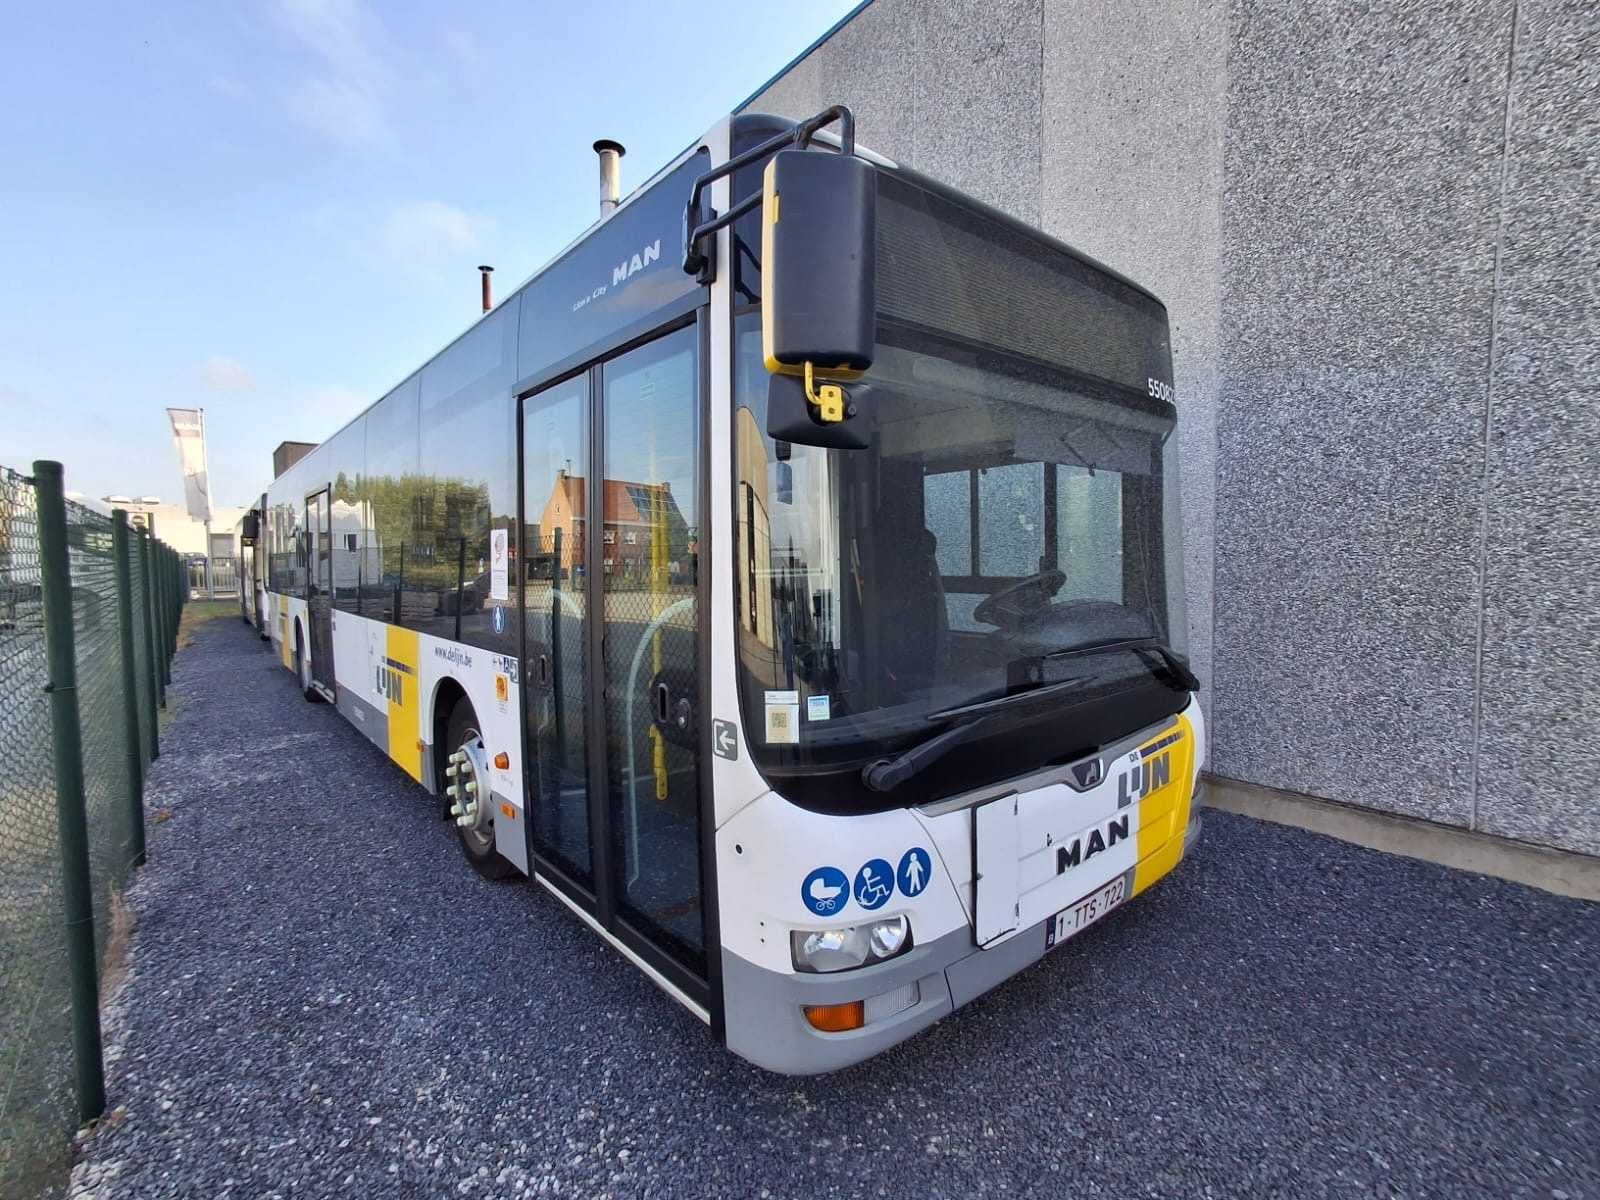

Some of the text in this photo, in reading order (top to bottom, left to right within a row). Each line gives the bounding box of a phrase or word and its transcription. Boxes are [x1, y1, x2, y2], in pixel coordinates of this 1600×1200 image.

[613, 239, 661, 286] MAN
[434, 646, 472, 668] www.delijn.be
[376, 664, 402, 706] LIJN
[1118, 751, 1170, 810] LIJN
[1056, 814, 1129, 875] MAN
